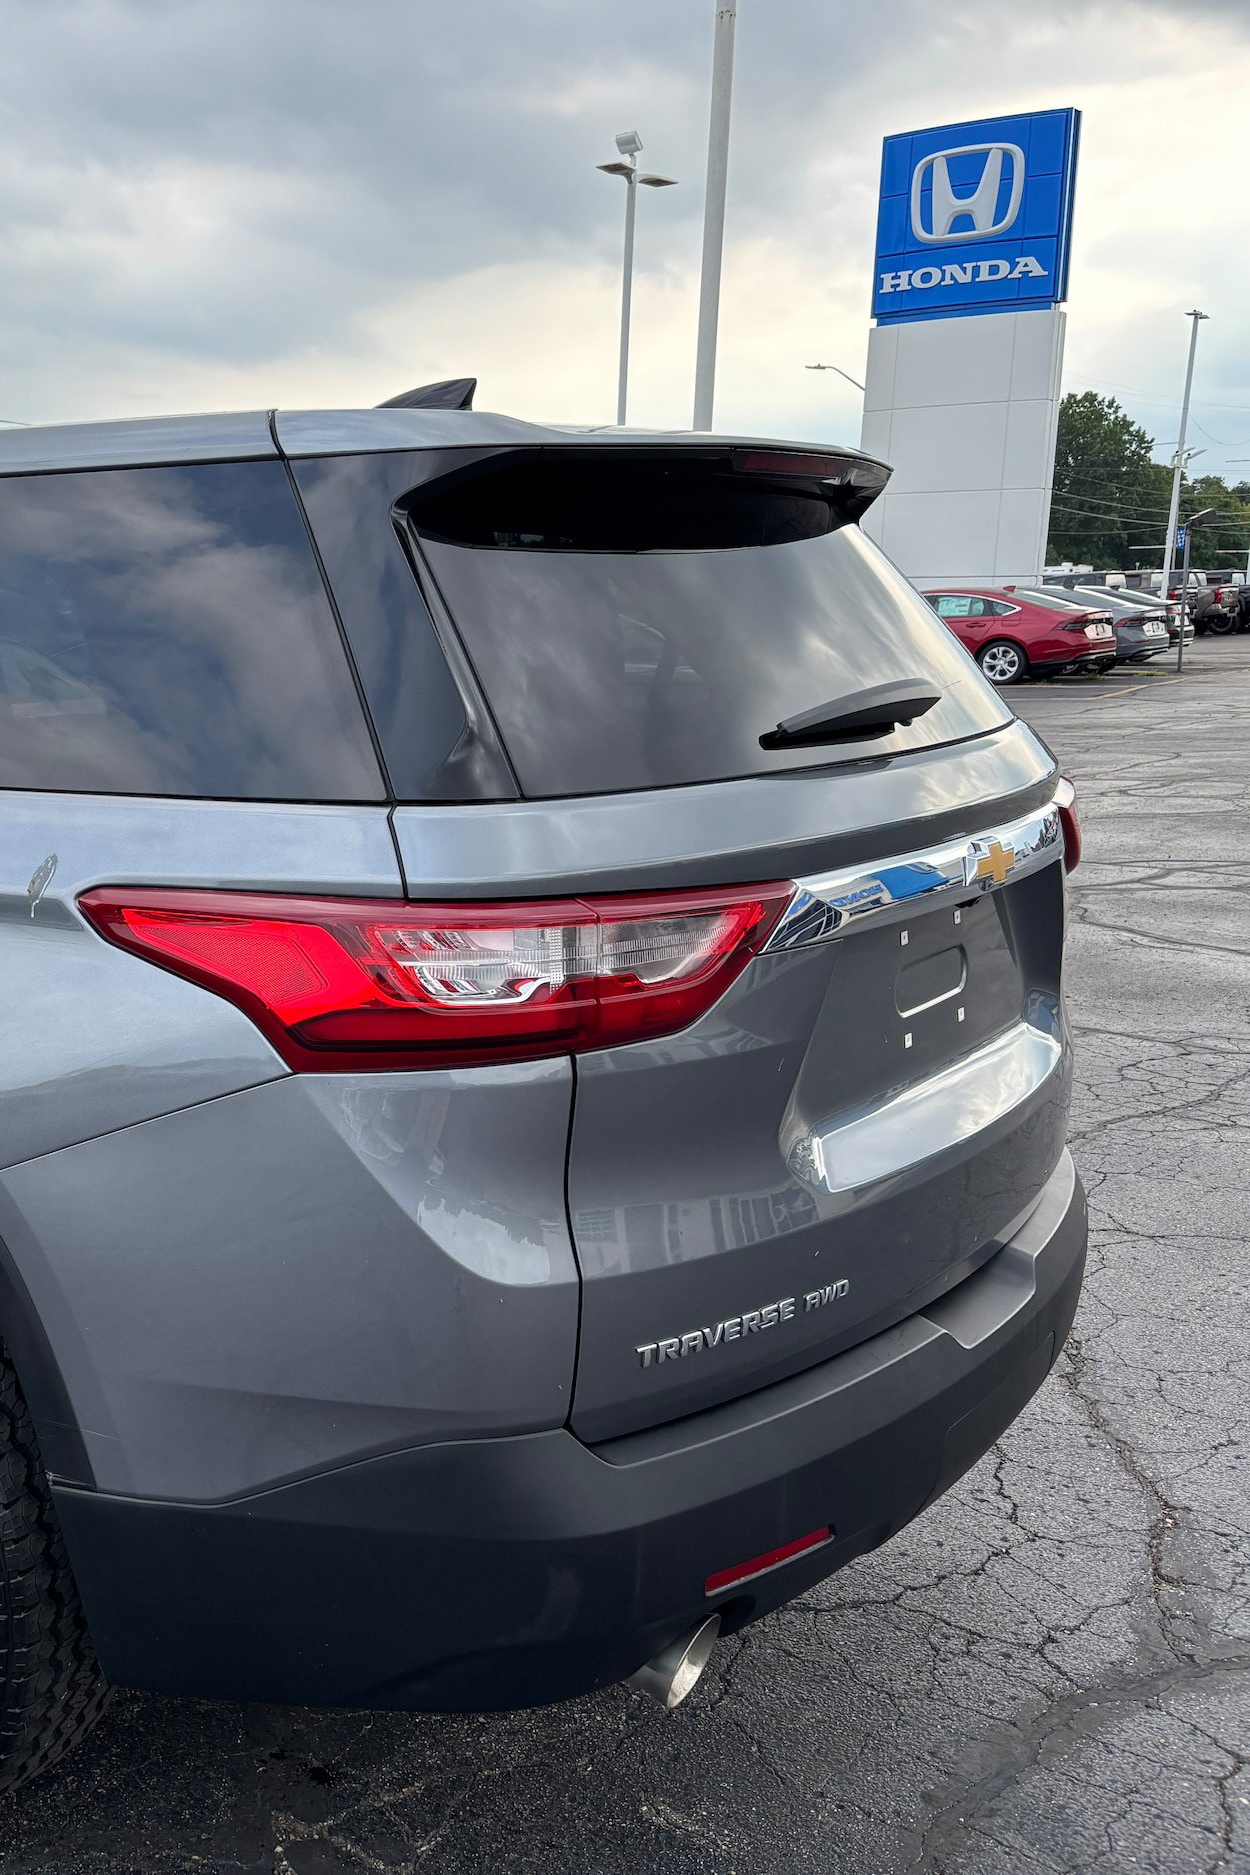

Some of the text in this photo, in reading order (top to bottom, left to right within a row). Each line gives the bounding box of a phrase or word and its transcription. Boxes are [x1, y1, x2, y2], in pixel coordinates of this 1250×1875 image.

[879, 256, 1048, 294] HONDA
[635, 1278, 850, 1368] TRAVERSE AWD
